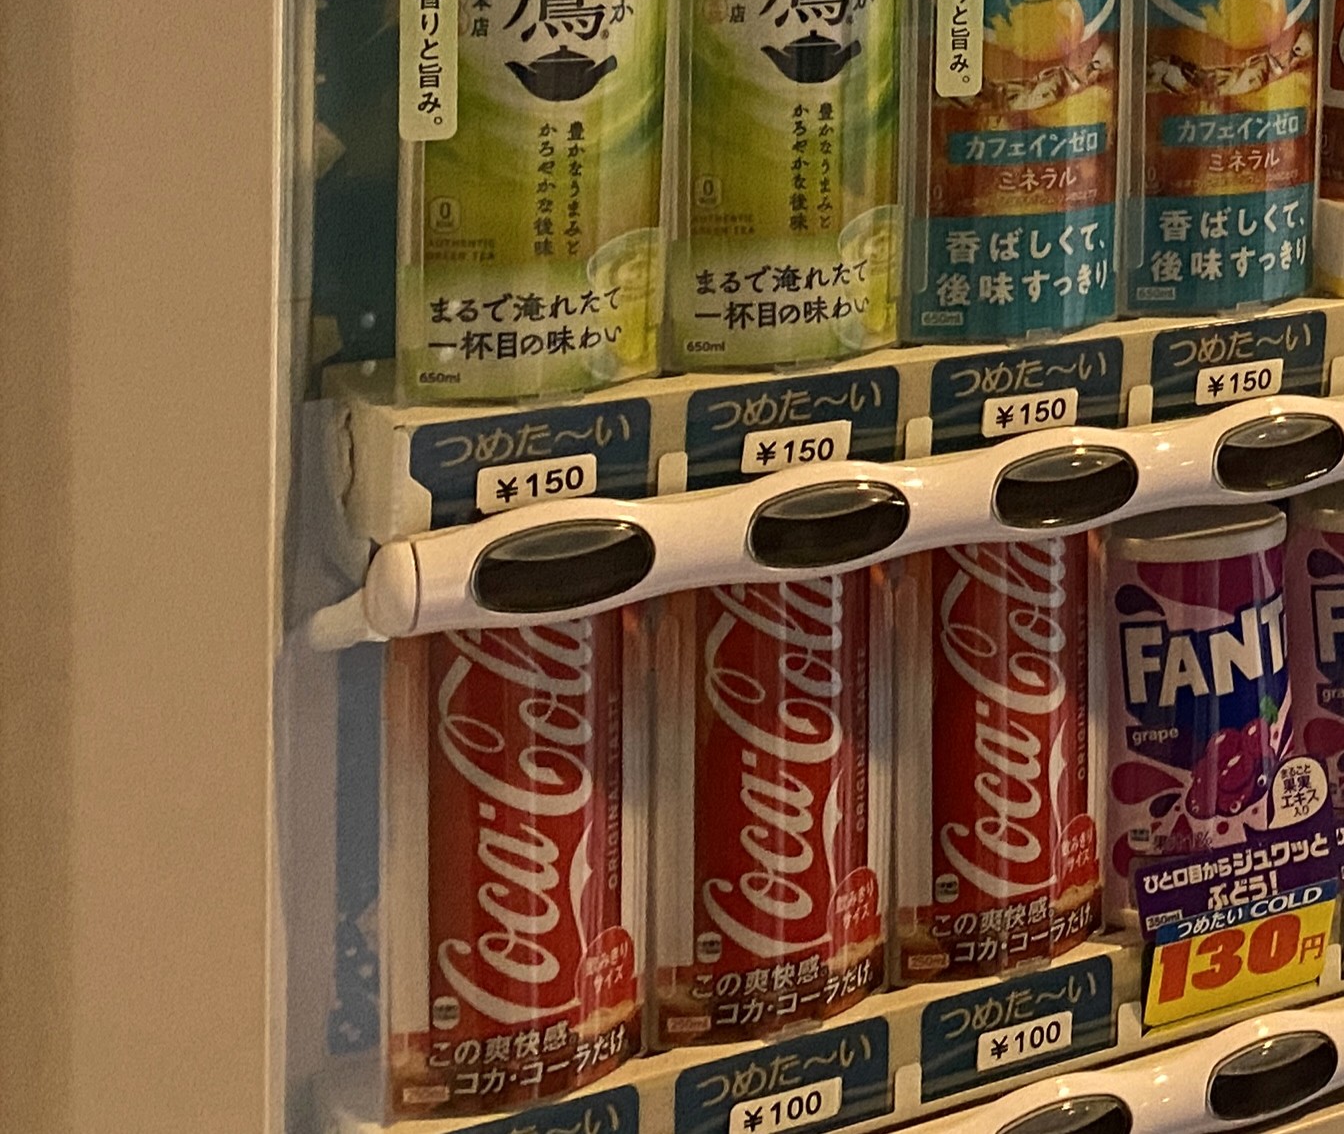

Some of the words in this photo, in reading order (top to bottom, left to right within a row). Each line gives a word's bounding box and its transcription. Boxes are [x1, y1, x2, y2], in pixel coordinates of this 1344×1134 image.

[965, 129, 1099, 161] カフェインゼロ
[1177, 114, 1301, 144] カフェインゼロ
[999, 166, 1078, 192] ミネラル
[694, 259, 870, 296] まるで淹れたて
[936, 258, 1109, 308] 後味すっきり
[429, 287, 622, 325] まるで淹れたて
[694, 294, 871, 329] 一杯目の味わい
[427, 323, 623, 361] 一杯目の味わい
[418, 372, 461, 385] 650ml
[1207, 368, 1273, 398] ¥150
[996, 396, 1067, 429] ¥150
[756, 436, 836, 465] ¥150
[496, 466, 585, 504] ¥150
[1123, 599, 1285, 709] FANT
[1131, 724, 1180, 746] grape
[1281, 789, 1319, 810] エキス
[1283, 774, 1312, 793] 果実
[1142, 831, 1331, 894] ひと口目からジュワッと
[1249, 885, 1323, 918] COLD
[1158, 913, 1326, 1005] 130円
[989, 1019, 1062, 1060] ¥100
